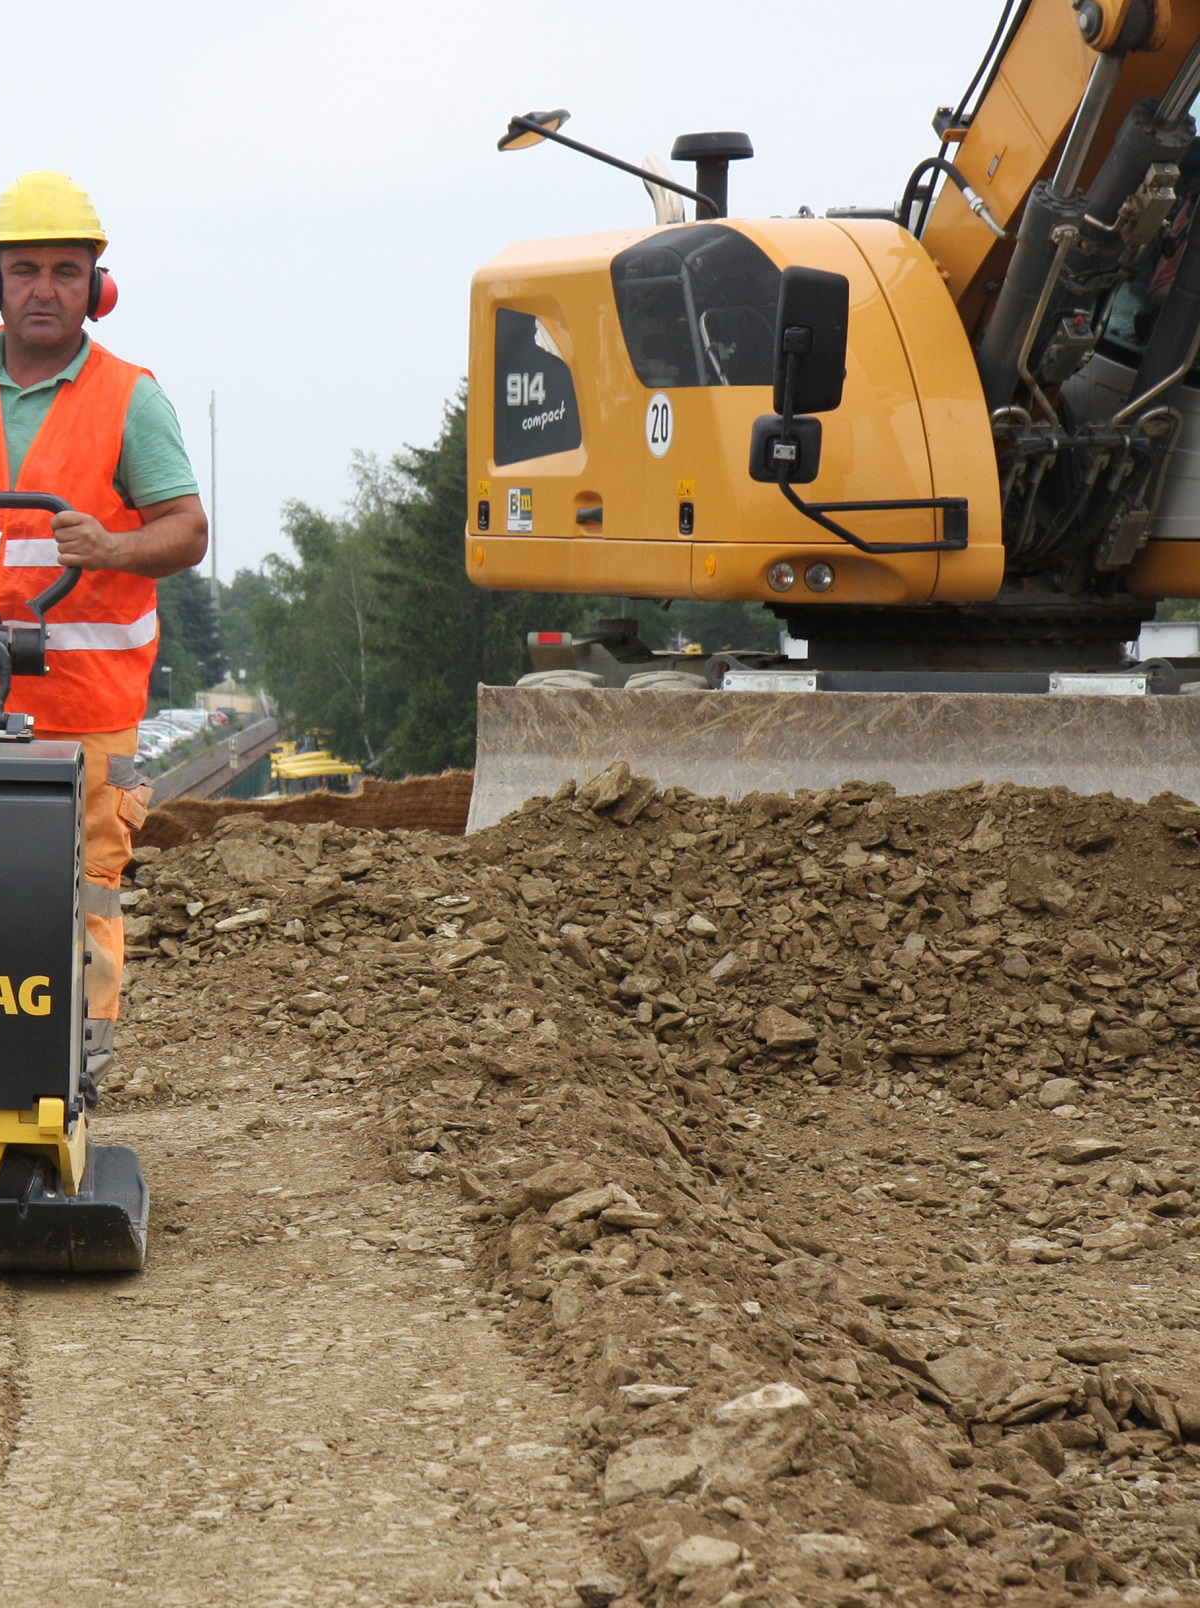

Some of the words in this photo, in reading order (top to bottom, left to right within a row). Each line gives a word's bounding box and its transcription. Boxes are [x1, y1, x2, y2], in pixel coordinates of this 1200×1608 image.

[506, 372, 546, 406] 914
[522, 400, 566, 430] compact
[651, 403, 669, 444] 20
